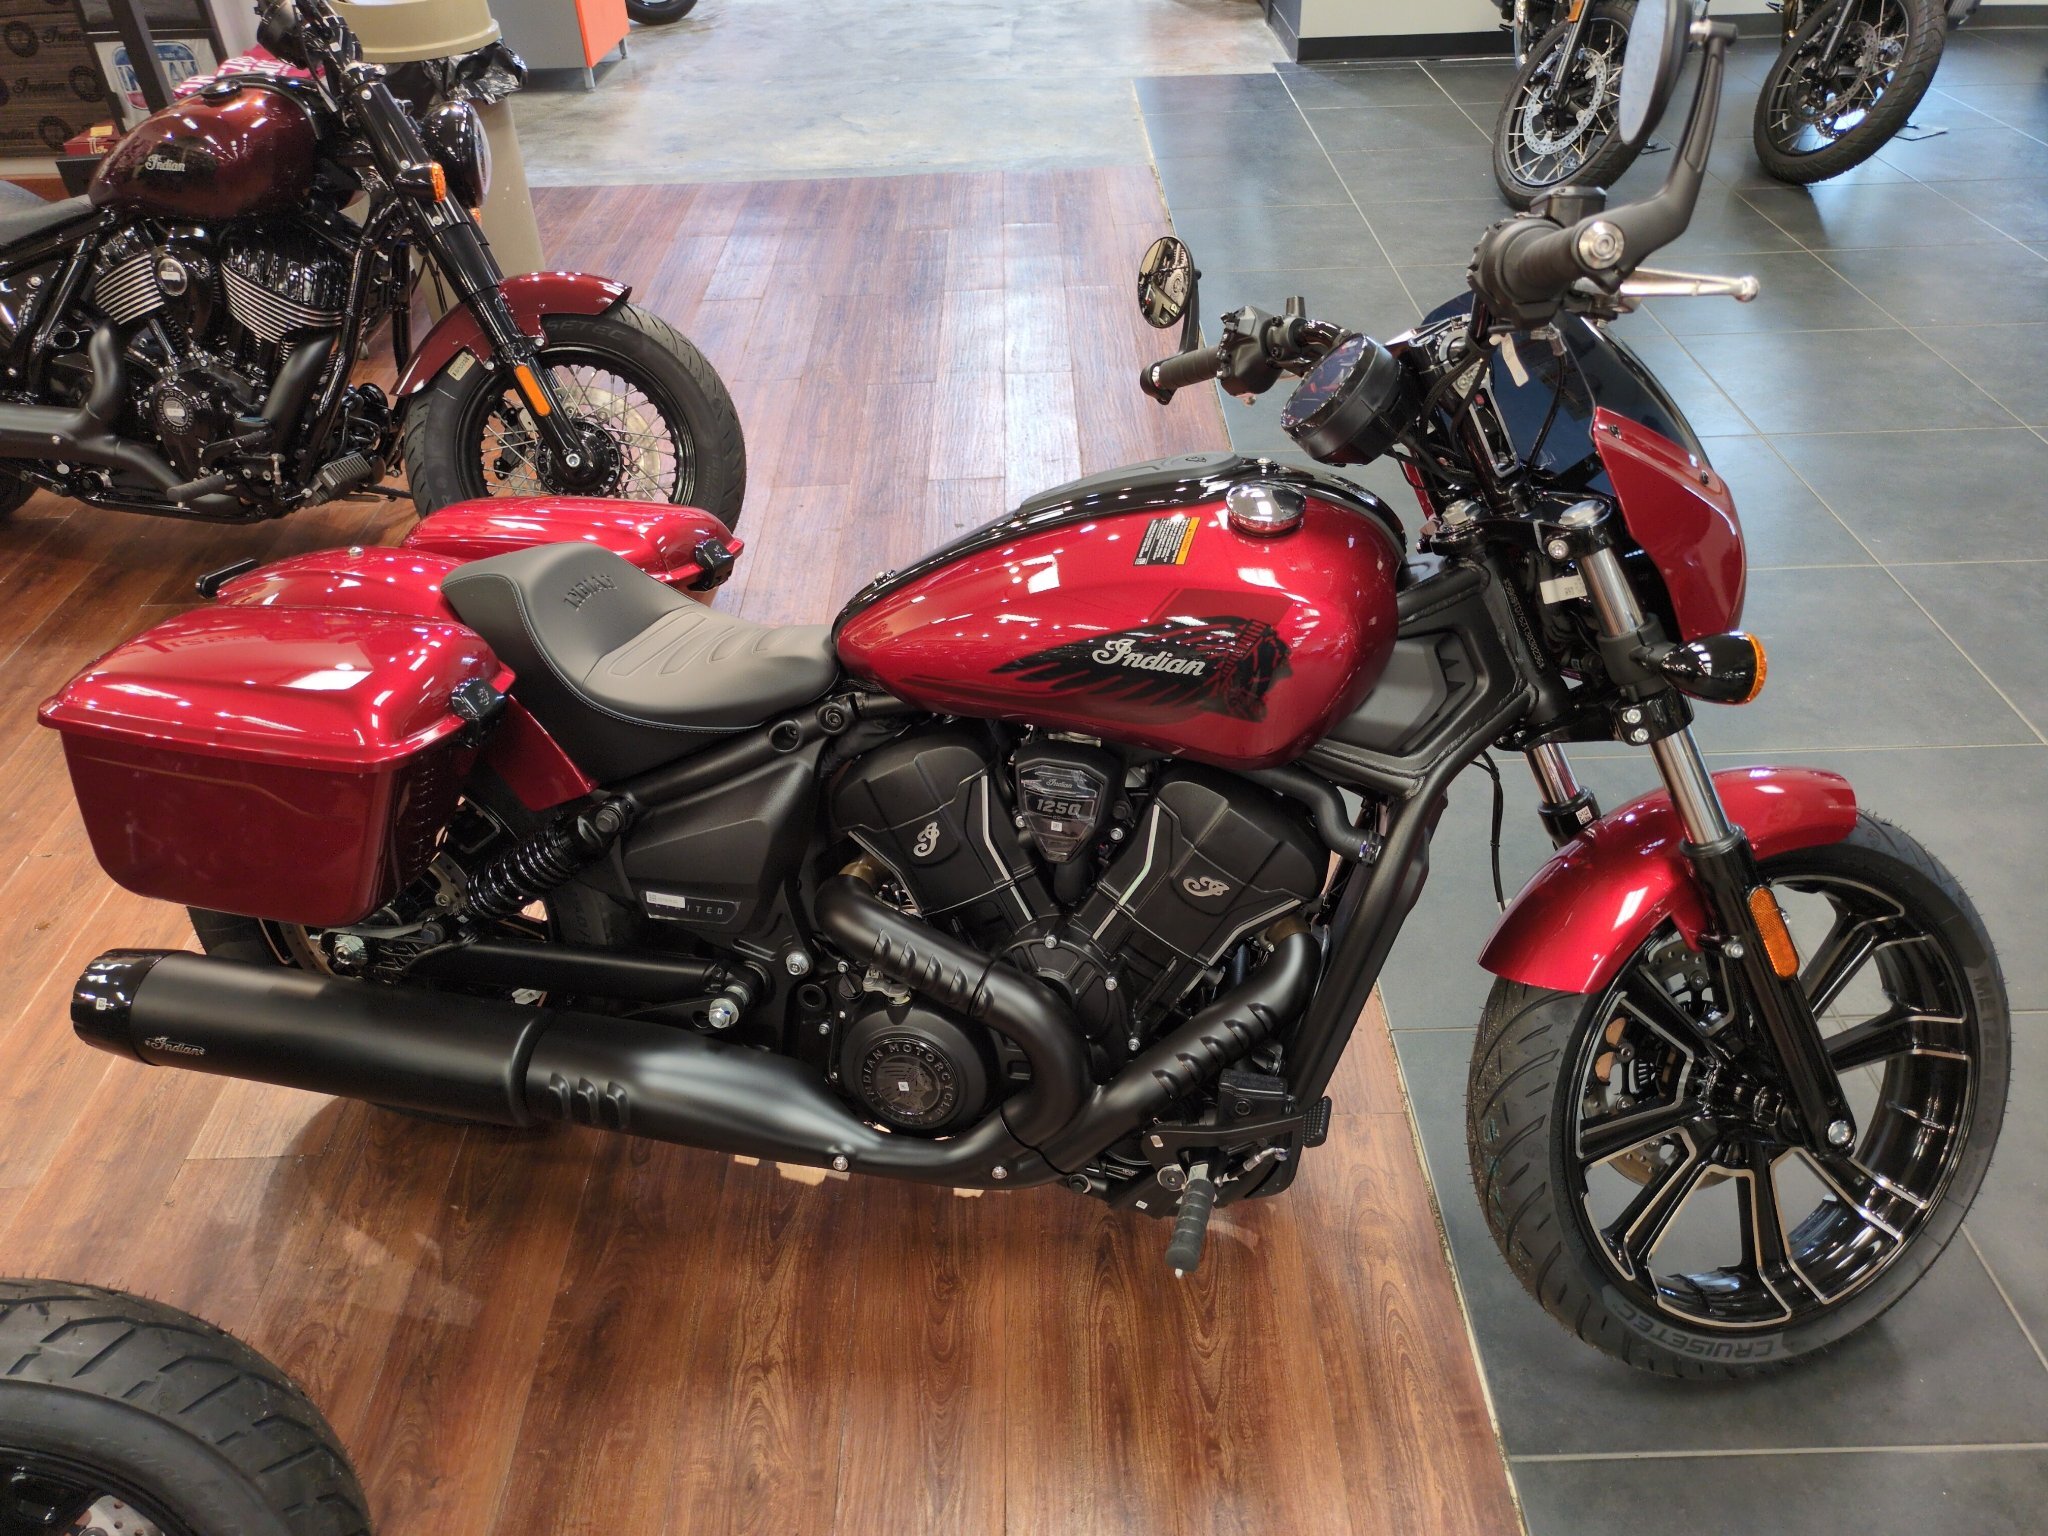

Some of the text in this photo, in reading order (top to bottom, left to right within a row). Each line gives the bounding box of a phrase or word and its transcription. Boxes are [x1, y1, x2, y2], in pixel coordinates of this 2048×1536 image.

[145, 153, 186, 172] Indian
[563, 574, 617, 611] INDIAN
[1092, 638, 1206, 676] Indian
[1045, 778, 1073, 789] Indian
[1036, 799, 1082, 816] 1250
[150, 1035, 201, 1056] Indian
[1618, 1302, 1775, 1358] CRUISETEC
